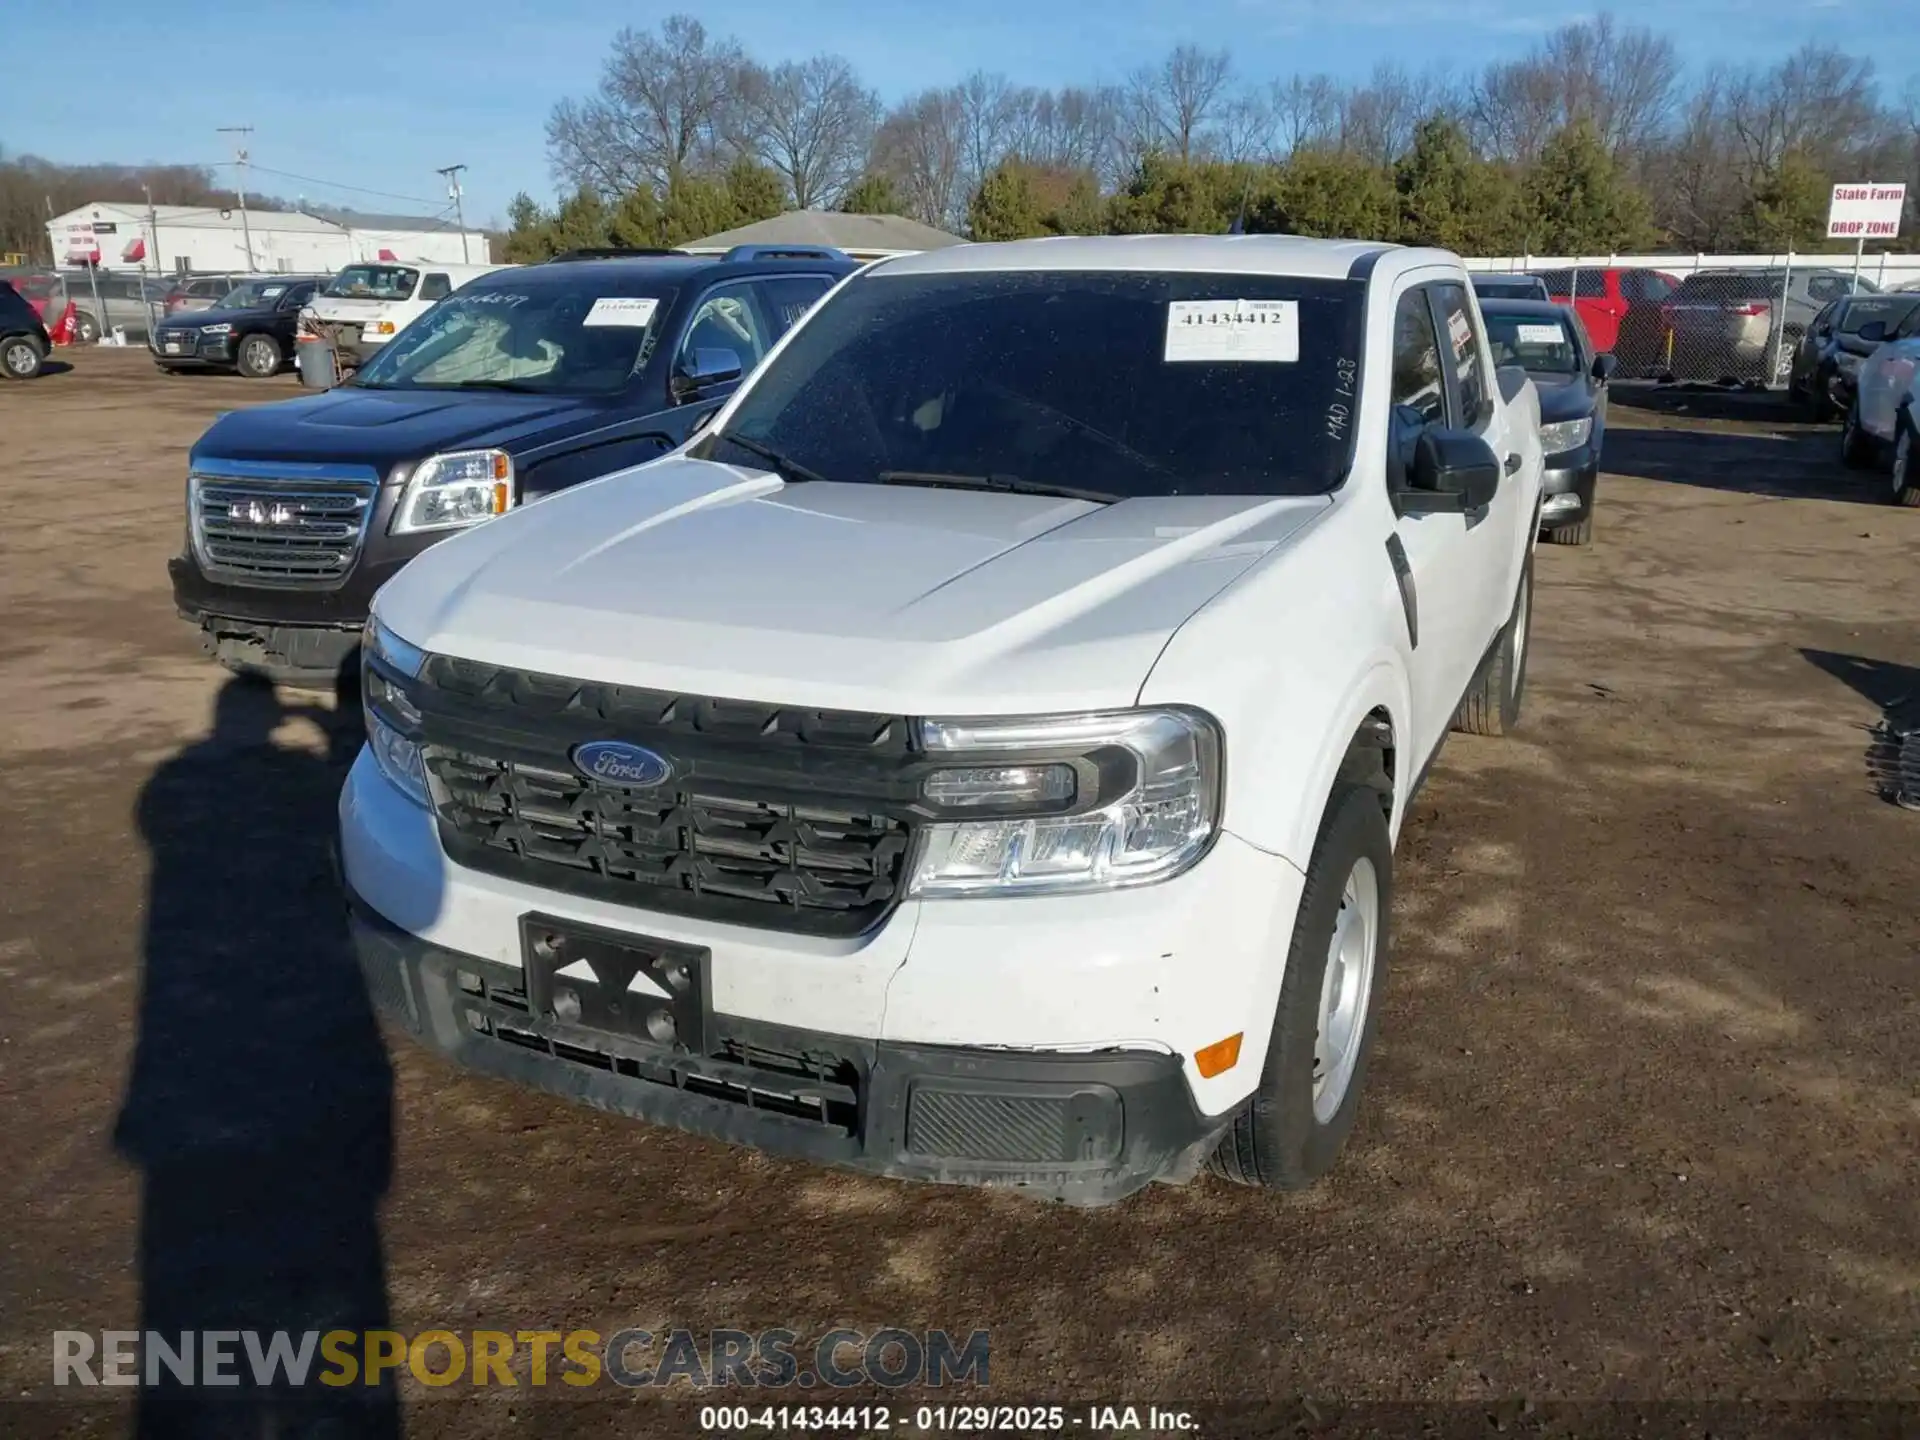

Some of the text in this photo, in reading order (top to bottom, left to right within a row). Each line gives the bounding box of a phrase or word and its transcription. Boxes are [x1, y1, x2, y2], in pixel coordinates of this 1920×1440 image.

[1835, 188, 1903, 200] State Farm
[1831, 222, 1896, 233] DROP ZONE
[1181, 313, 1281, 324] 41434412
[594, 750, 645, 780] Ford
